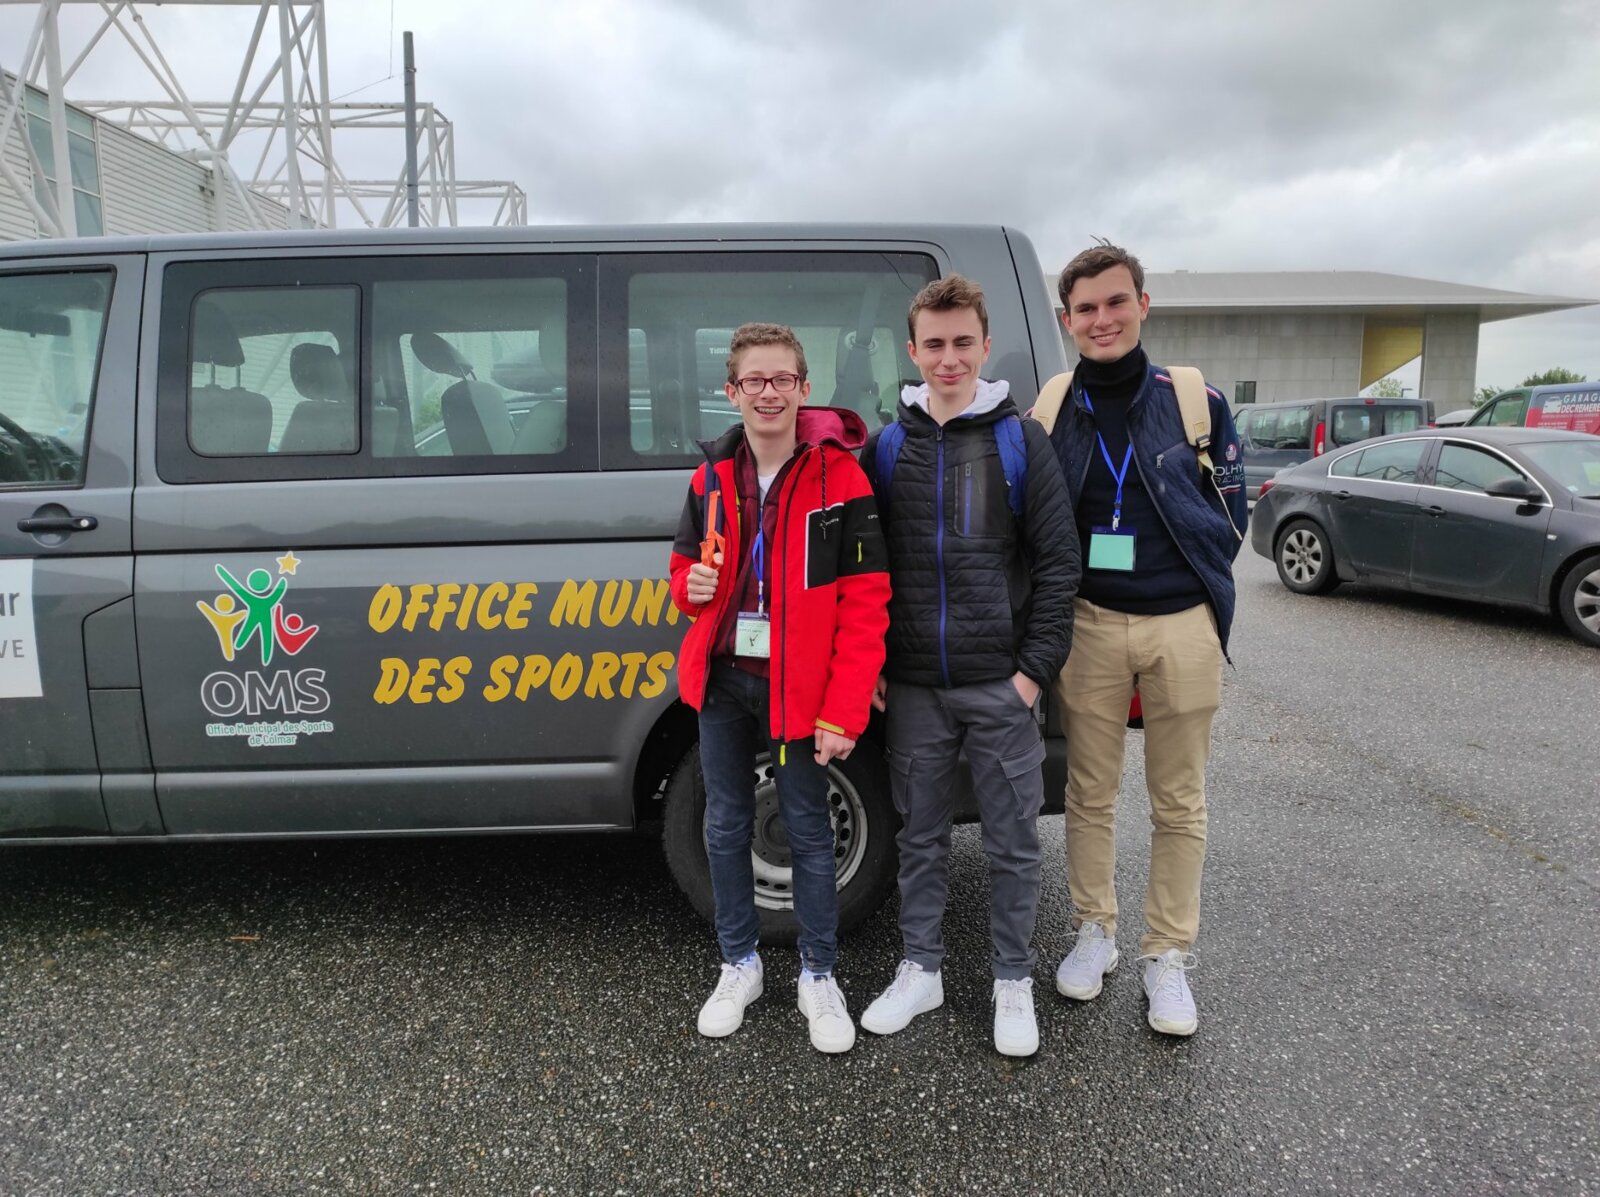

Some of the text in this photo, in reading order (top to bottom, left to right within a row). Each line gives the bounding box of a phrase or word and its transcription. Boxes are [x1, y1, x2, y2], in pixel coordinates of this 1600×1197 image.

[1563, 392, 1600, 403] GARAG
[368, 578, 697, 633] OFFICE MUNI
[200, 667, 331, 717] OMS
[373, 651, 675, 704] DES SPORTS
[206, 720, 333, 736] Office Municipal des Sports
[249, 733, 297, 746] de Colmar
